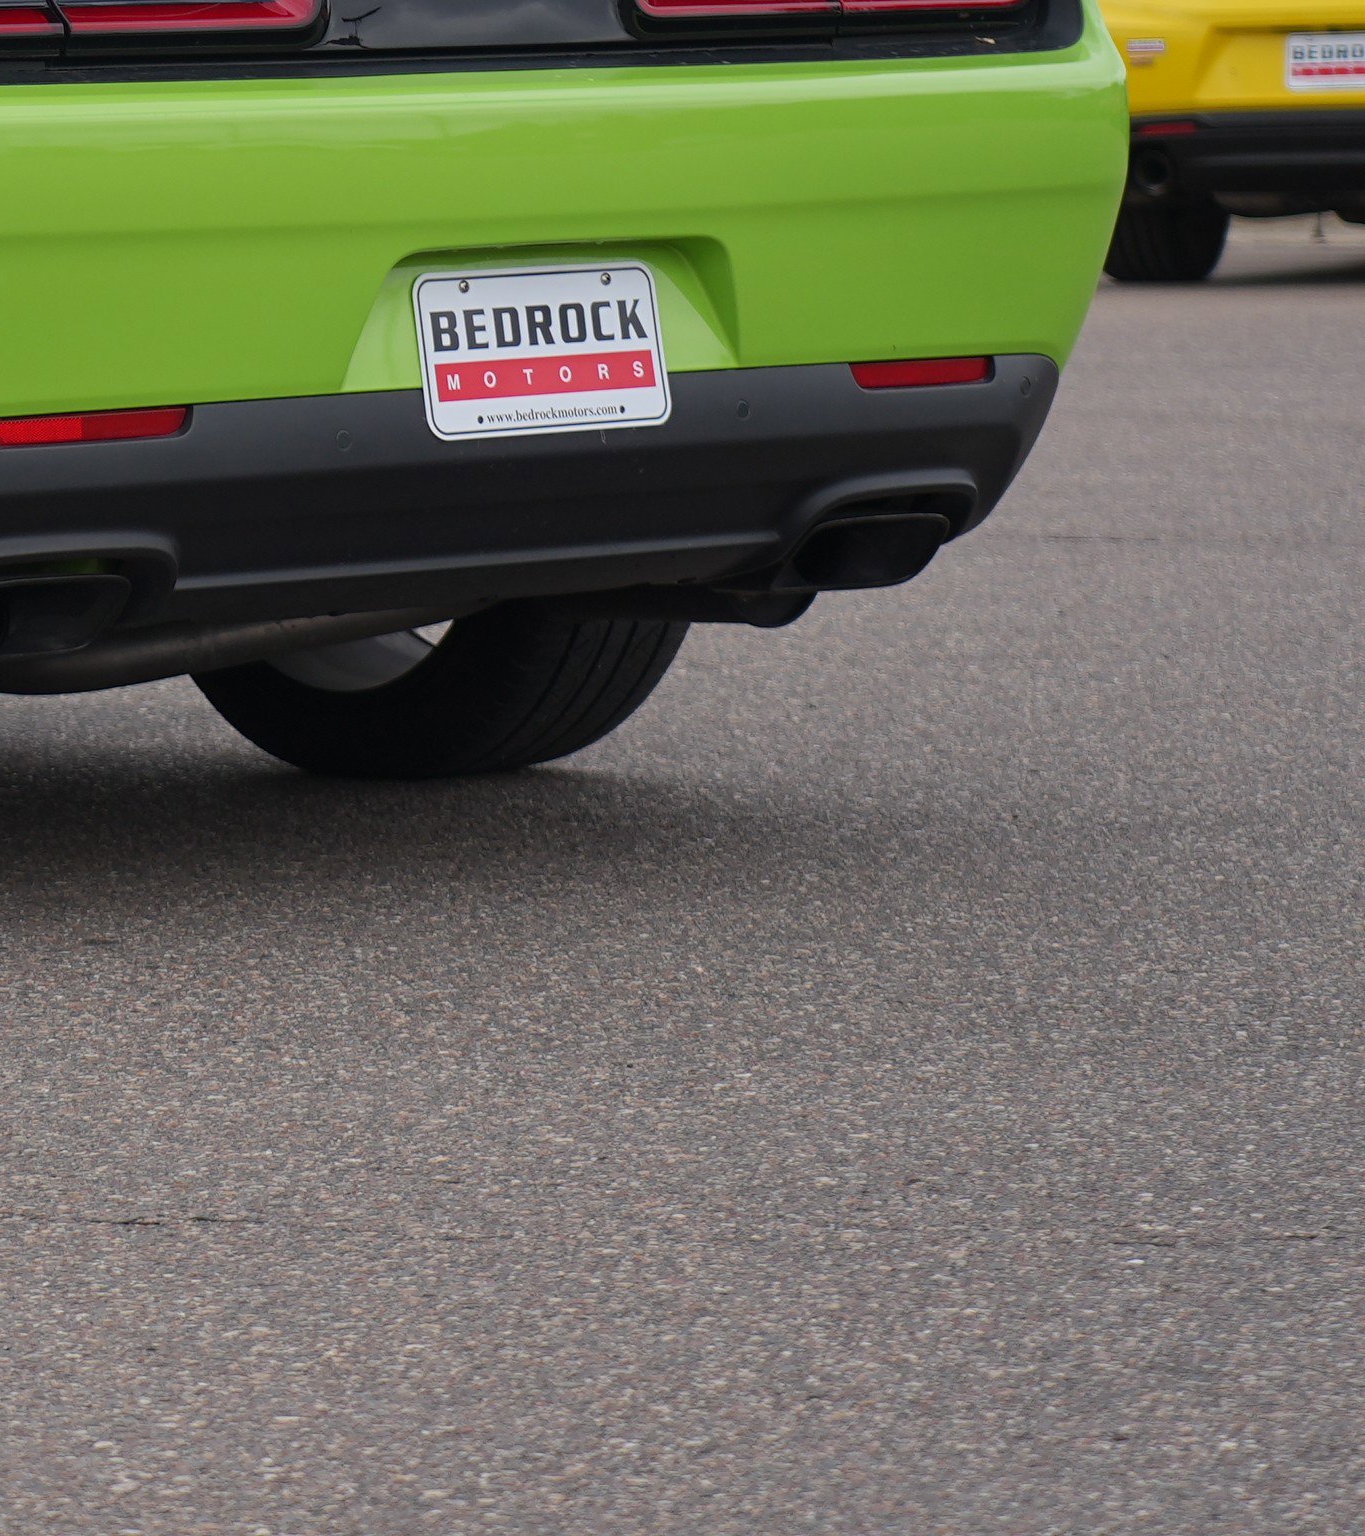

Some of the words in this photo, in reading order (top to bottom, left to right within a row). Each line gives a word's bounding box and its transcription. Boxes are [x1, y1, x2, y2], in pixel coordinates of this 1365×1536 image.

[428, 298, 649, 353] BEDROCK
[446, 359, 646, 391] MOTORS
[486, 404, 618, 425] www.bedrockmotors.com
